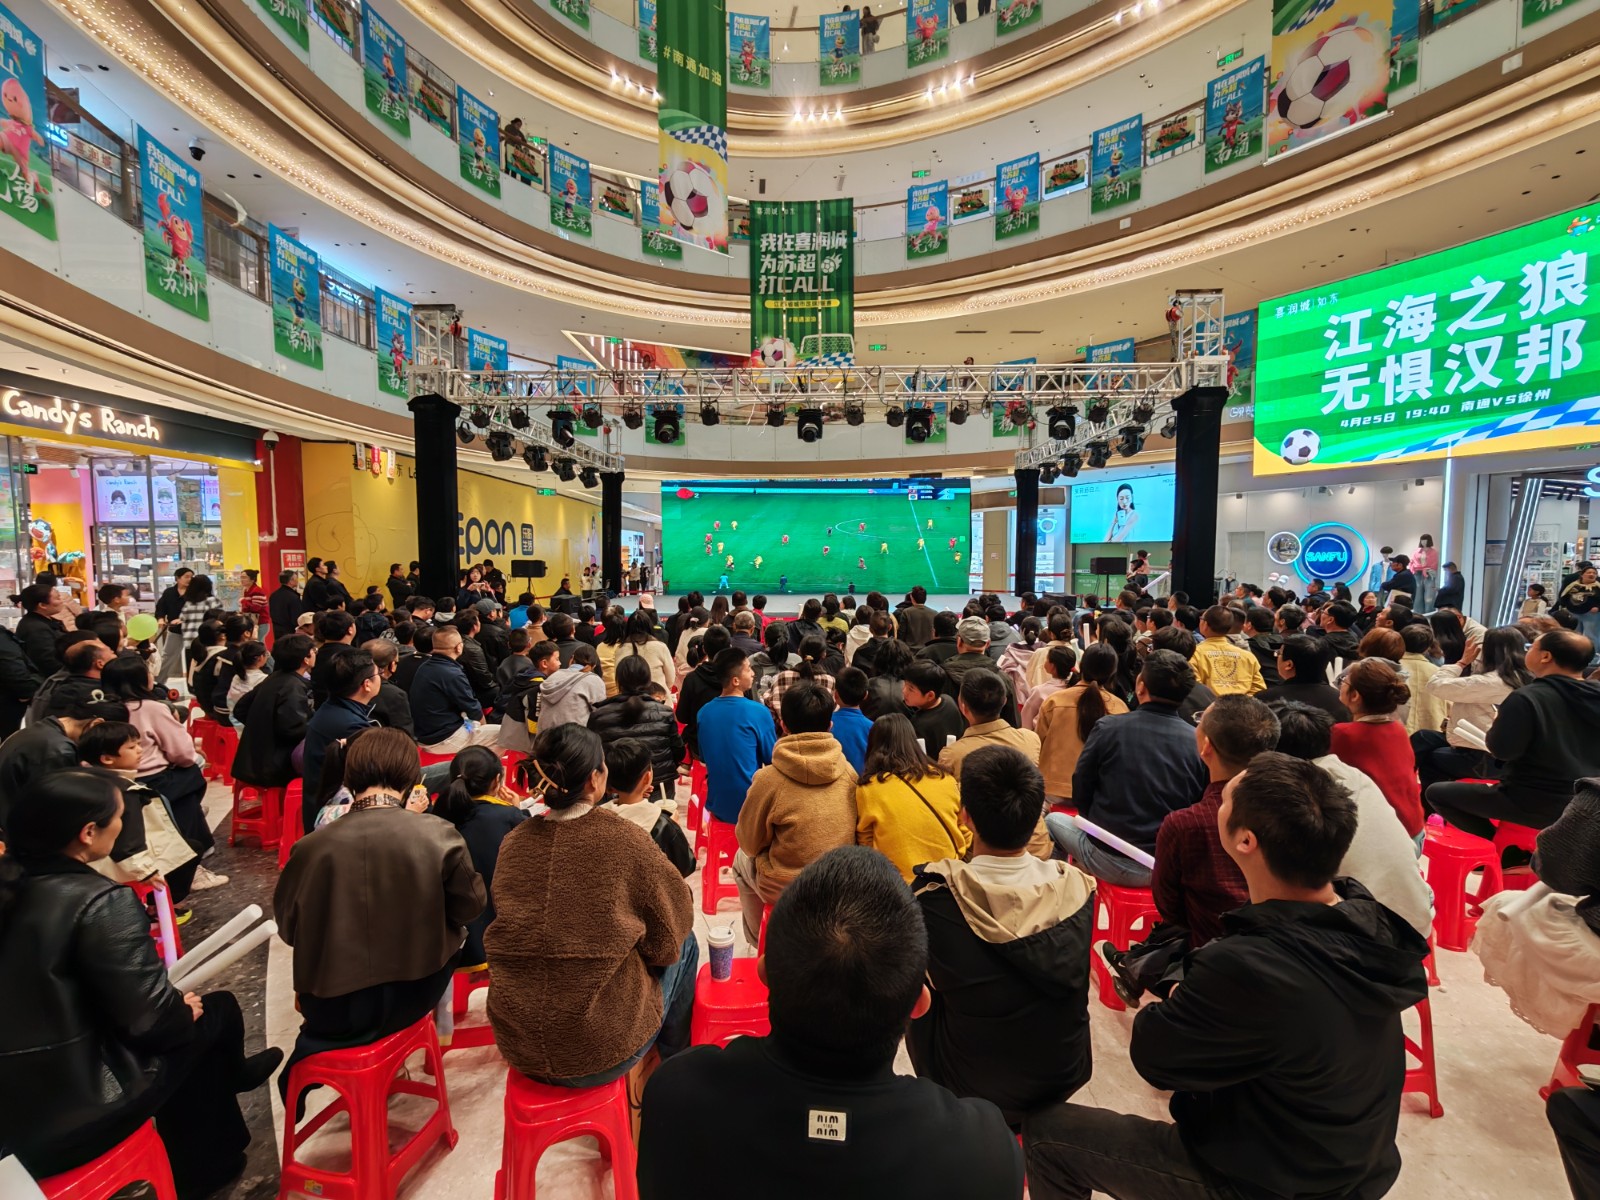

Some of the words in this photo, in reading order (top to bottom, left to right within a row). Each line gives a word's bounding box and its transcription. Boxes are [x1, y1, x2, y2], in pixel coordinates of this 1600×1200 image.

[663, 45, 722, 86] #南通加油
[760, 230, 847, 252] 我在喜润城
[760, 253, 816, 273] 为苏超
[759, 275, 835, 294] 打CALL
[1275, 299, 1310, 319] 喜润城
[1323, 250, 1588, 361] 江海之狼
[1321, 318, 1587, 415] 无惧汉邦
[2, 390, 92, 435] Candy's
[101, 406, 160, 441] Ranch
[1340, 412, 1396, 428] 4月25日
[1405, 404, 1450, 420] 19:40
[1460, 388, 1552, 412] 南通VS徐州
[1306, 551, 1347, 562] SANFU
